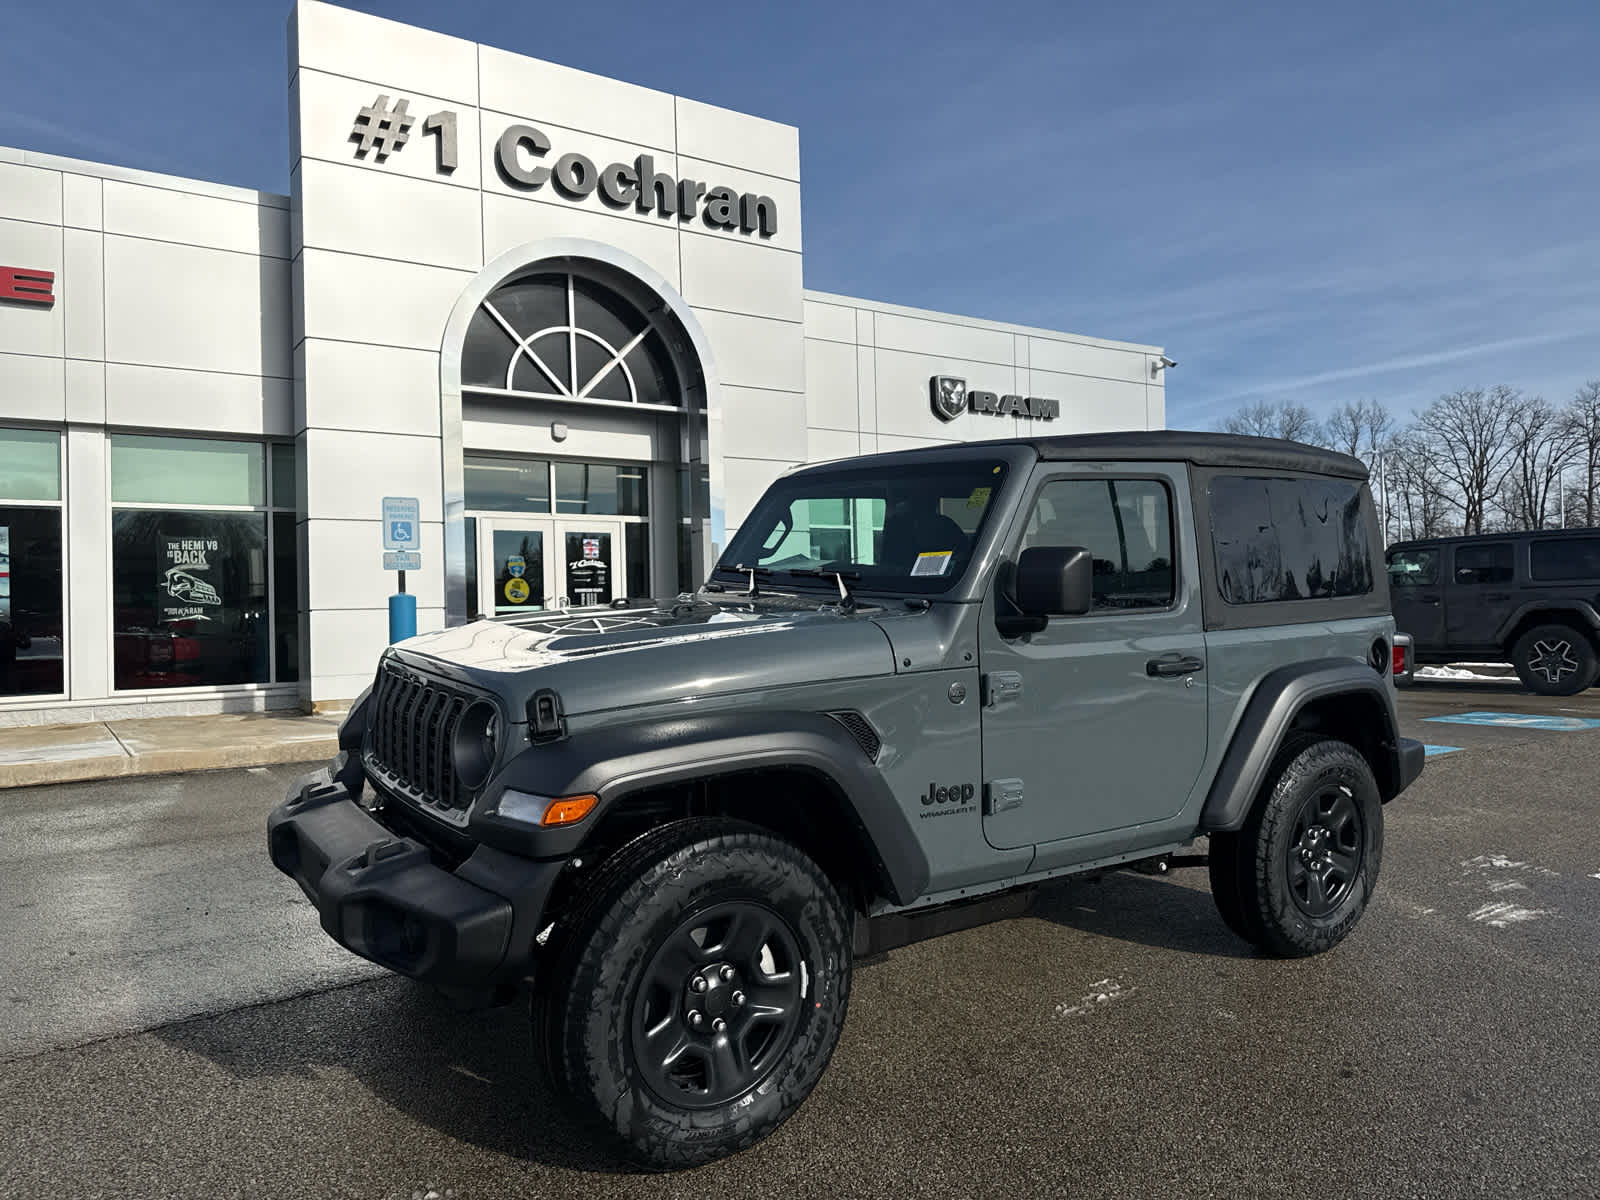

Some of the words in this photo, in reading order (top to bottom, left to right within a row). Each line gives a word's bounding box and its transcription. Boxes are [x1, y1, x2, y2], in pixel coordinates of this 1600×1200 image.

[347, 94, 458, 177] #1
[494, 124, 777, 239] Cochran
[967, 390, 1060, 422] RAM
[168, 542, 180, 550] THE
[182, 540, 204, 550] HEMI
[206, 540, 218, 550] V8
[174, 551, 206, 564] BACK
[190, 606, 204, 615] RAM
[921, 782, 975, 806] Jeep
